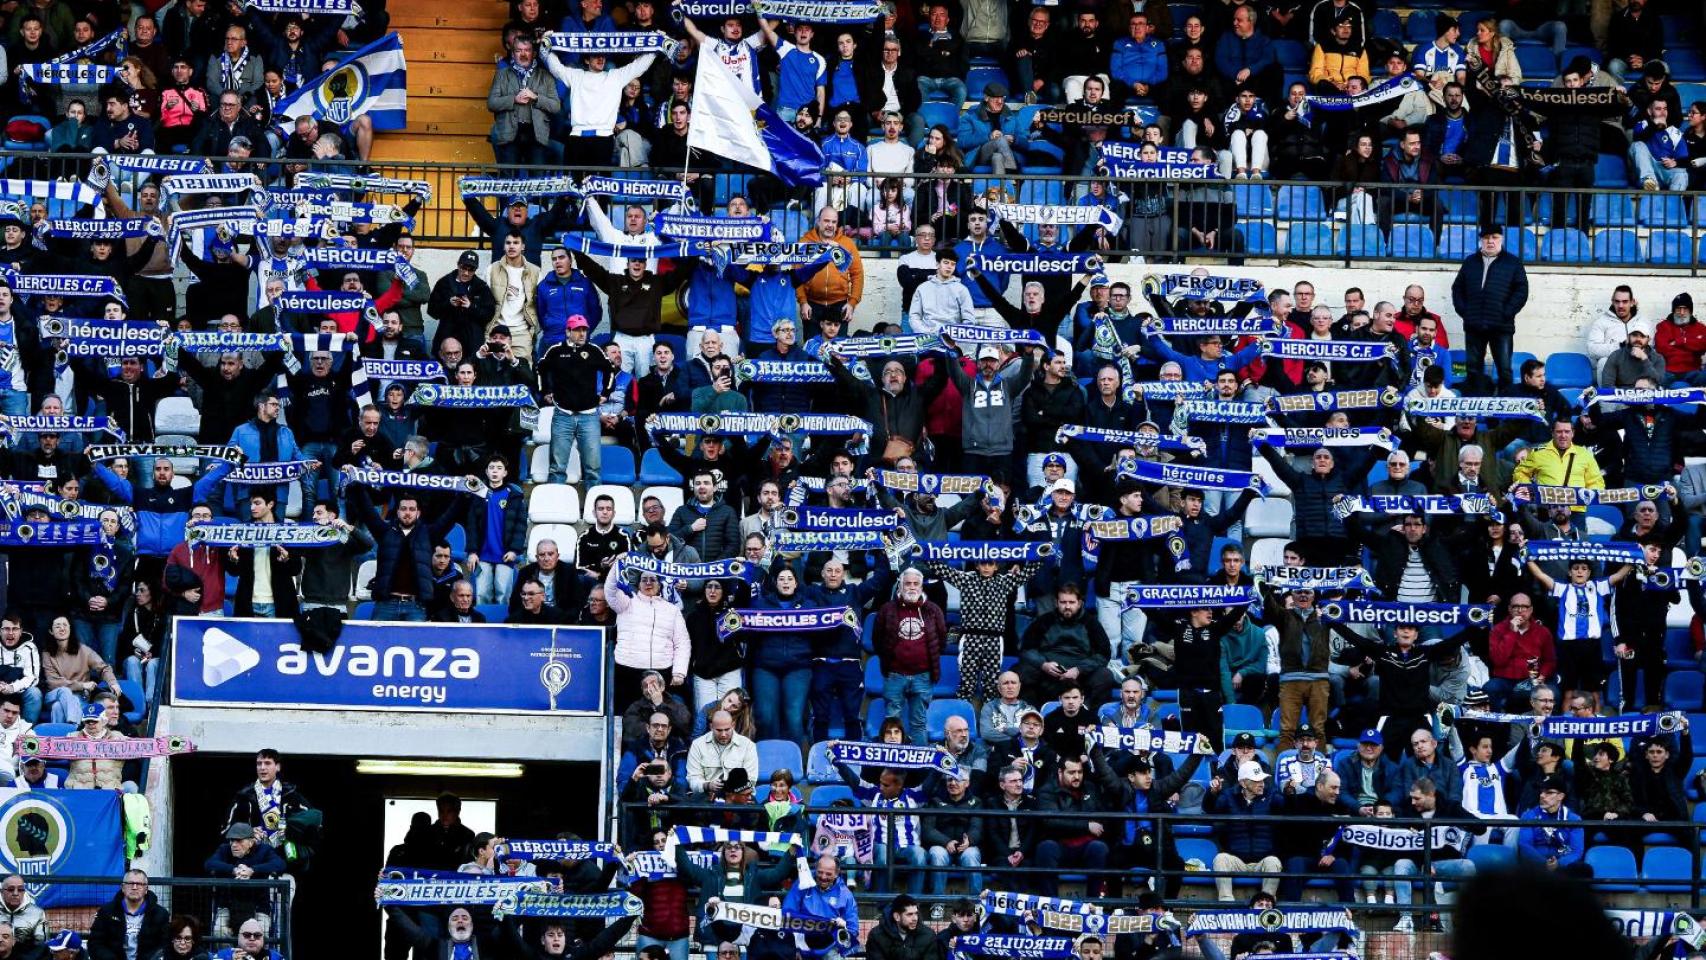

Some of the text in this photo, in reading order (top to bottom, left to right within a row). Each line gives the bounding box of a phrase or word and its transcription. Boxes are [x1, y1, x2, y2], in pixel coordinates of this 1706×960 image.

[1103, 142, 1188, 164] HÉRCLES
[660, 223, 764, 239] ANTIELCHERO
[981, 256, 1078, 272] hérculescf
[1172, 318, 1237, 331] HERCULES
[1281, 343, 1347, 356] HERCULES
[757, 361, 831, 375] HERCUL
[1184, 400, 1265, 416] HERCULE
[1279, 390, 1378, 411] 1922 2022
[11, 416, 69, 428] ERCULES
[231, 465, 283, 481] ERCULES
[883, 470, 919, 490] 1922
[1162, 465, 1225, 483] hércules
[1538, 485, 1577, 504] 1922
[928, 541, 1031, 560] hérculescf
[625, 556, 657, 571] ACHO
[1142, 588, 1199, 599] GRACIAS
[1349, 603, 1460, 623] hérculescf
[277, 642, 481, 680] avanza
[372, 683, 447, 704] energy
[1633, 721, 1650, 733] CF
[595, 843, 613, 852] CF
[1043, 911, 1153, 933] 1922 2022
